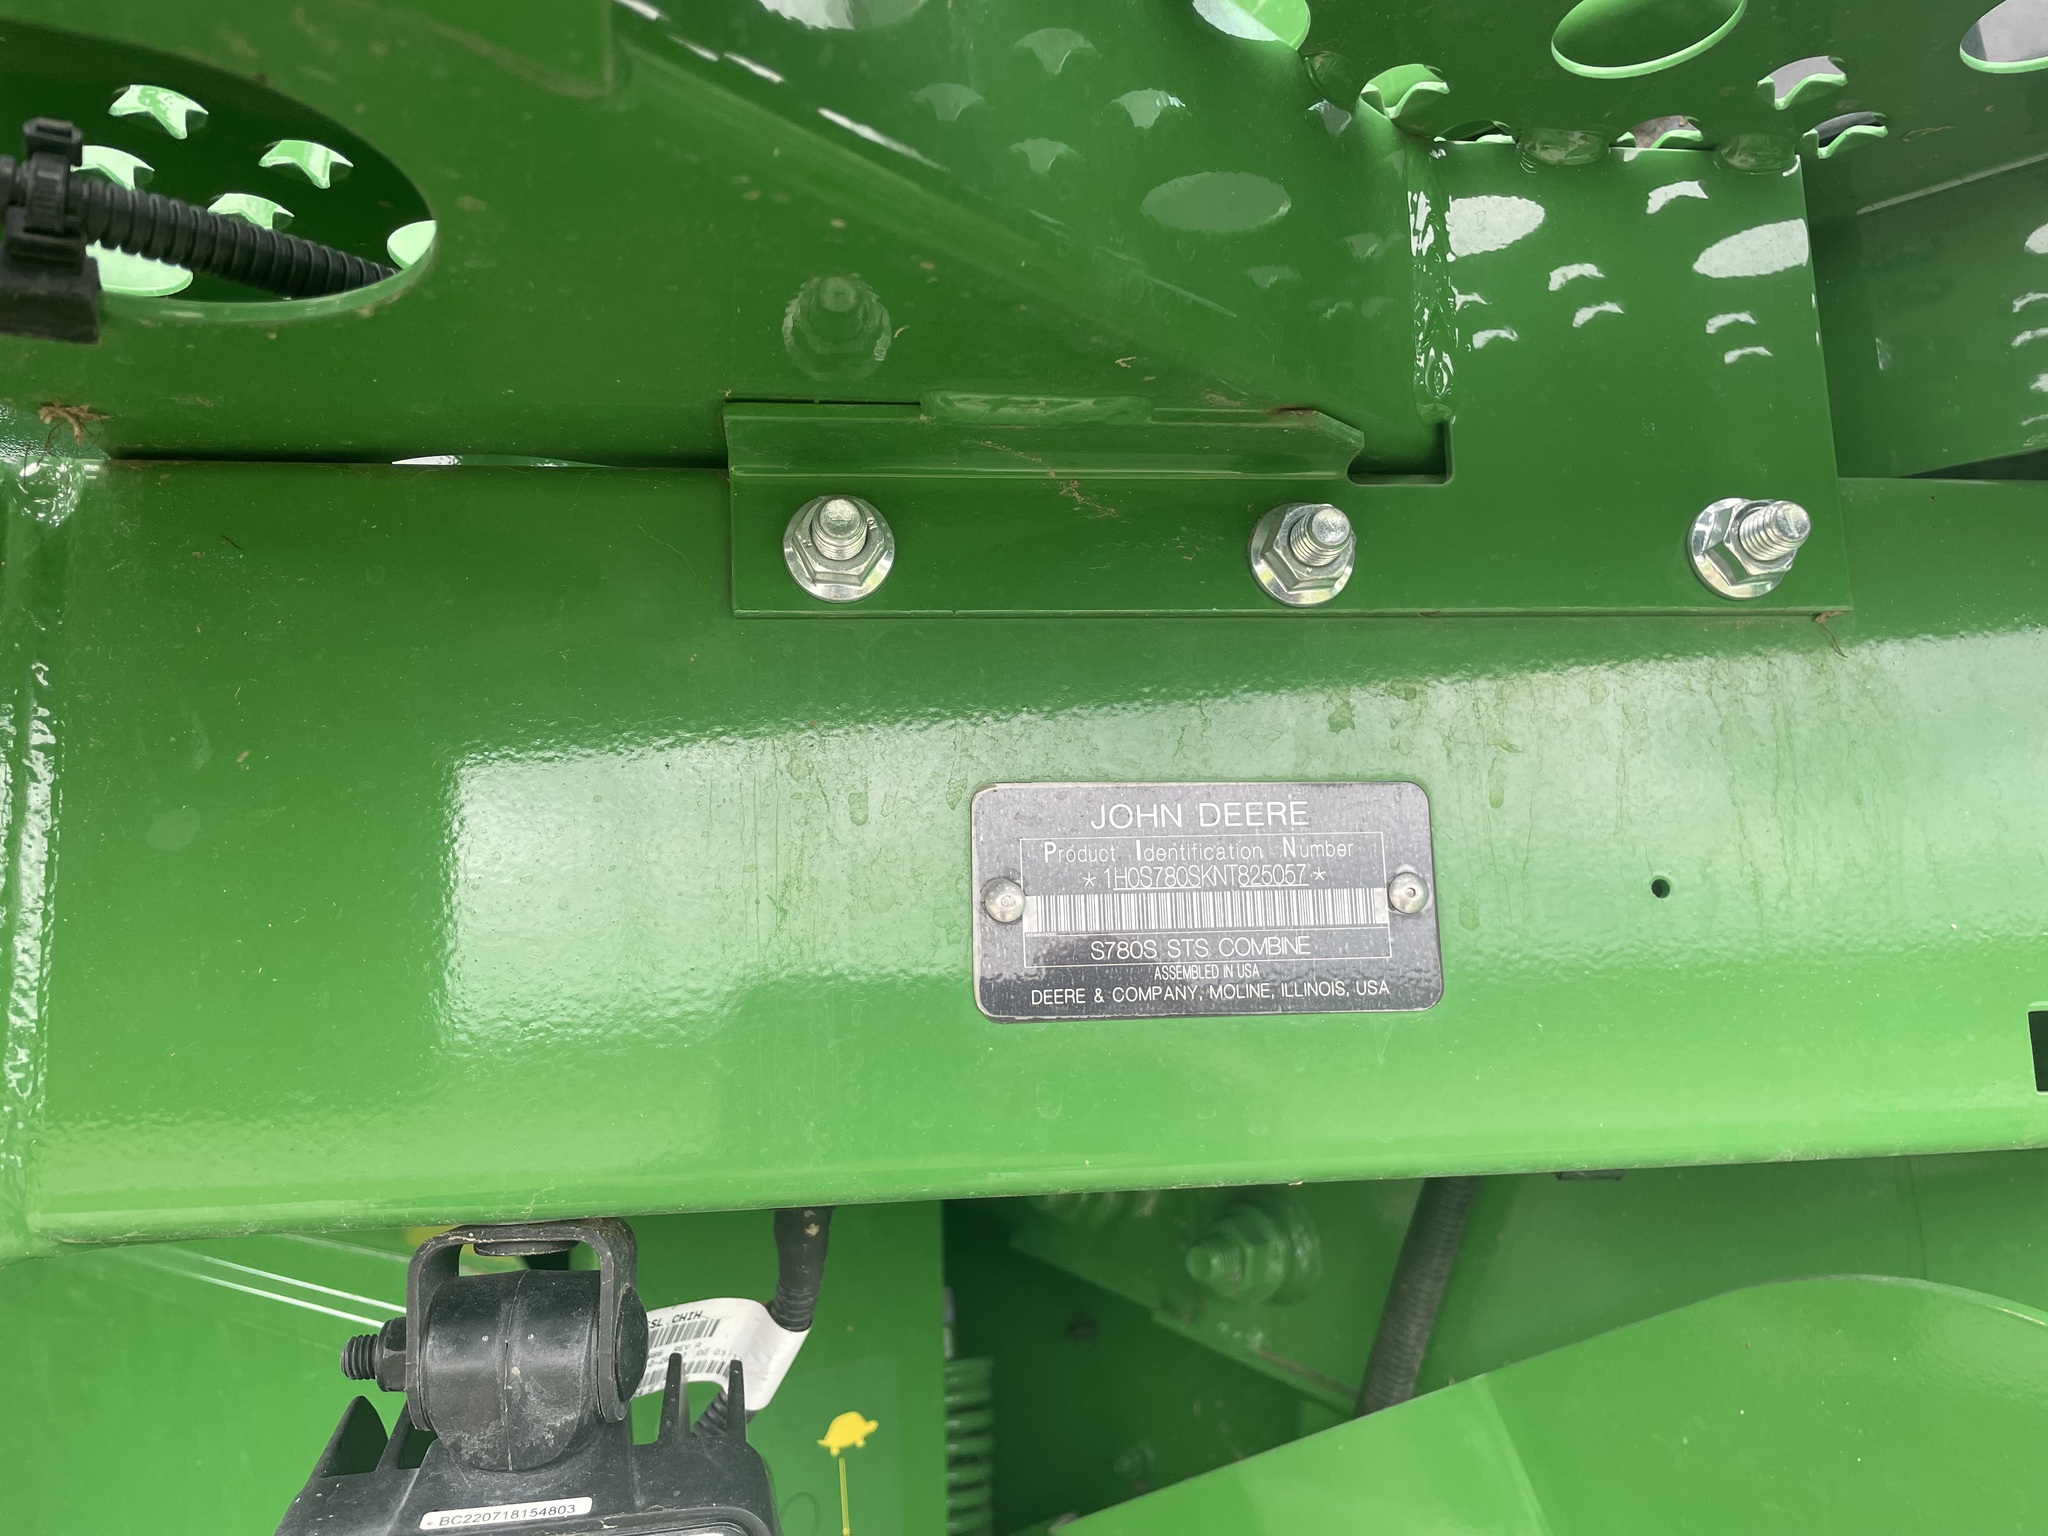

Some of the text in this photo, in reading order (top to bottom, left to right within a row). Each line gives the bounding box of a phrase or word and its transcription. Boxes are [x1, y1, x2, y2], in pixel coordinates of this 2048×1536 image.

[1090, 800, 1309, 830] JOHN DEERE
[1043, 836, 1354, 864] Product Identification Number
[1090, 935, 1311, 961] S780S STS COMBINE
[1153, 962, 1260, 980] ASSEMBLED IN USA
[1030, 979, 1391, 1006] DEERE & COMPANY, MOLINE, ILLINOIS, USA
[438, 1503, 577, 1527] BC220718154803
